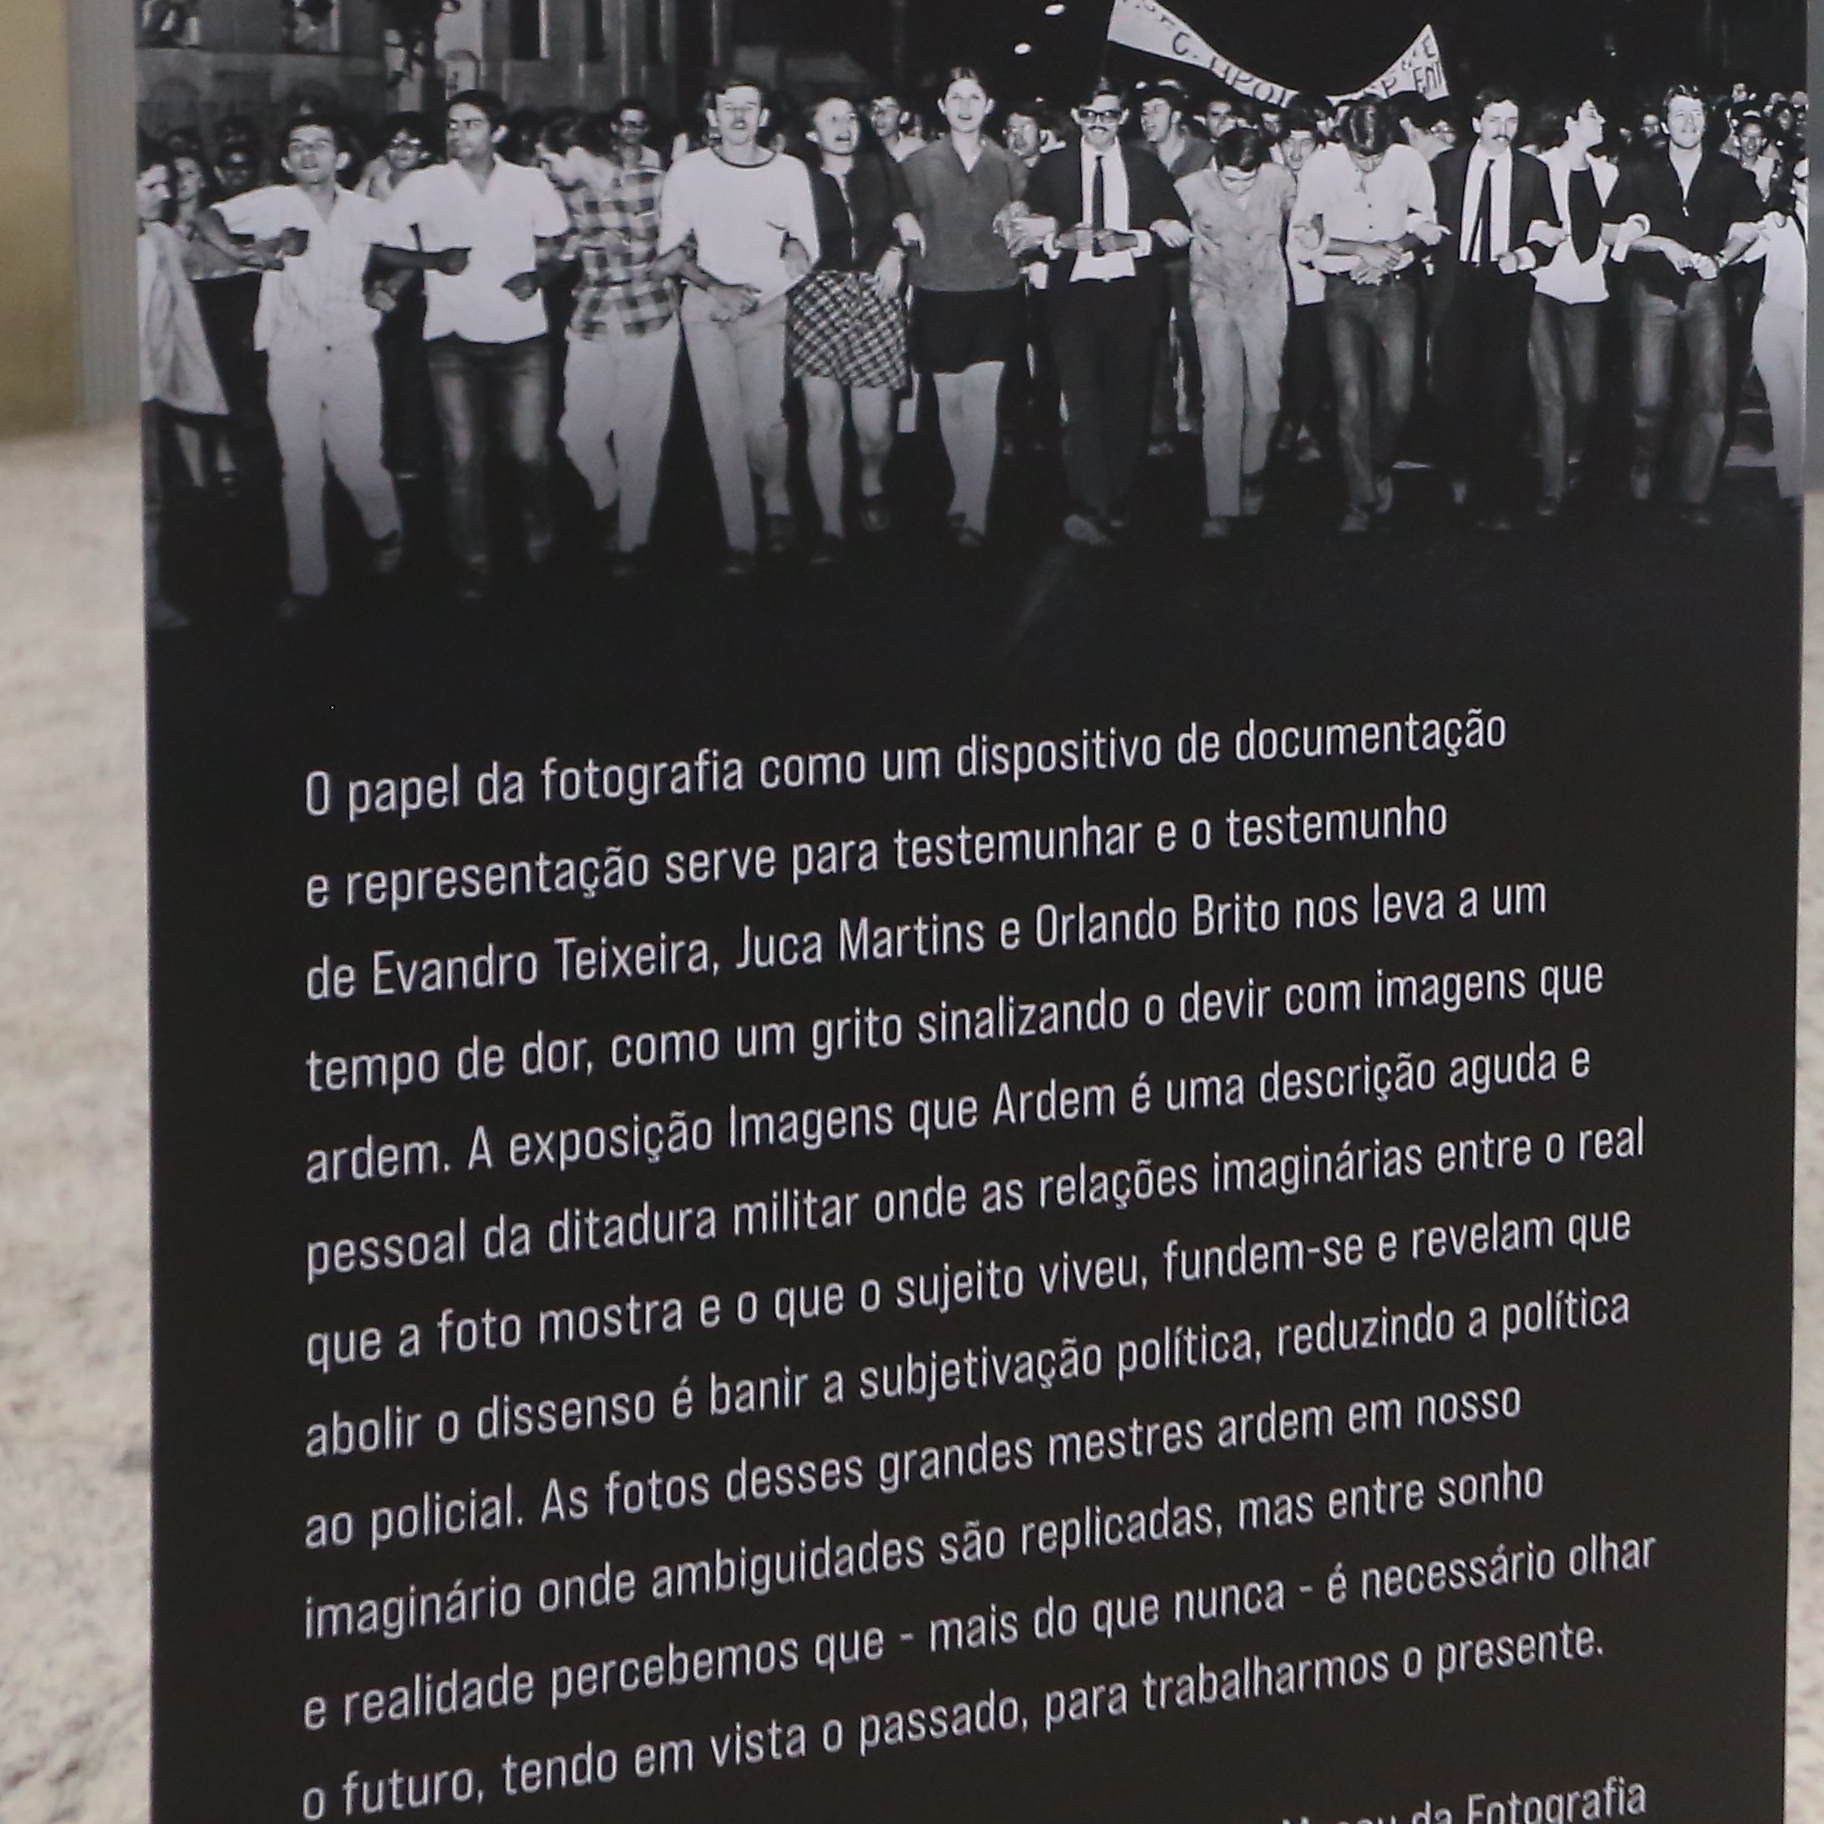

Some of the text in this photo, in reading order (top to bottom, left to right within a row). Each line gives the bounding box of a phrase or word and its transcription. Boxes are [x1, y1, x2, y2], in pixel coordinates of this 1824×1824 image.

[306, 708, 1505, 822] O papel da fotografia como um dispositivo de documentação
[307, 795, 1447, 911] e representação serve para testemunhar e o testemunho
[307, 882, 1545, 1000] de Evandro Teixeira, Juca Martins e Orlando Brito nos leva a um
[306, 963, 1603, 1094] tempo de dor, como um grito sinalizando o devir com imagens que
[307, 1041, 1589, 1183] ardem. A exposição Imagens que Ardem é uma descrição aguda e
[308, 1116, 1643, 1284] pessoal da ditadura militar onde as relações imaginárias entre o real
[306, 1288, 1629, 1457] abolir o dissenso é banir a subjetivação política, reduzindo a política
[307, 1210, 1630, 1373] que a foto mostra e o que o sujeito viveu, fundem-se e revelam que
[306, 1387, 1520, 1550] ao policial. As fotos desses grandes mestres ardem em nosso
[306, 1460, 1543, 1639] imaginário onde ambiguidades são replicadas, mas entre sonho
[304, 1697, 326, 1730] e
[345, 1662, 533, 1726] realidade
[552, 1638, 798, 1709] percebemos
[815, 1627, 884, 1674] que
[931, 1603, 1018, 1652] mais
[1034, 1595, 1077, 1639] do
[1093, 1594, 1159, 1638] que
[1175, 1580, 1284, 1622] nunca
[1328, 1562, 1347, 1603] é
[1362, 1541, 1555, 1600] necessário
[1569, 1532, 1656, 1576] olhar
[303, 1622, 1603, 1821] o futuro, tendo em vista o passado, para trabalharmos o presente.
[1467, 1776, 1648, 1824] Fotografia
